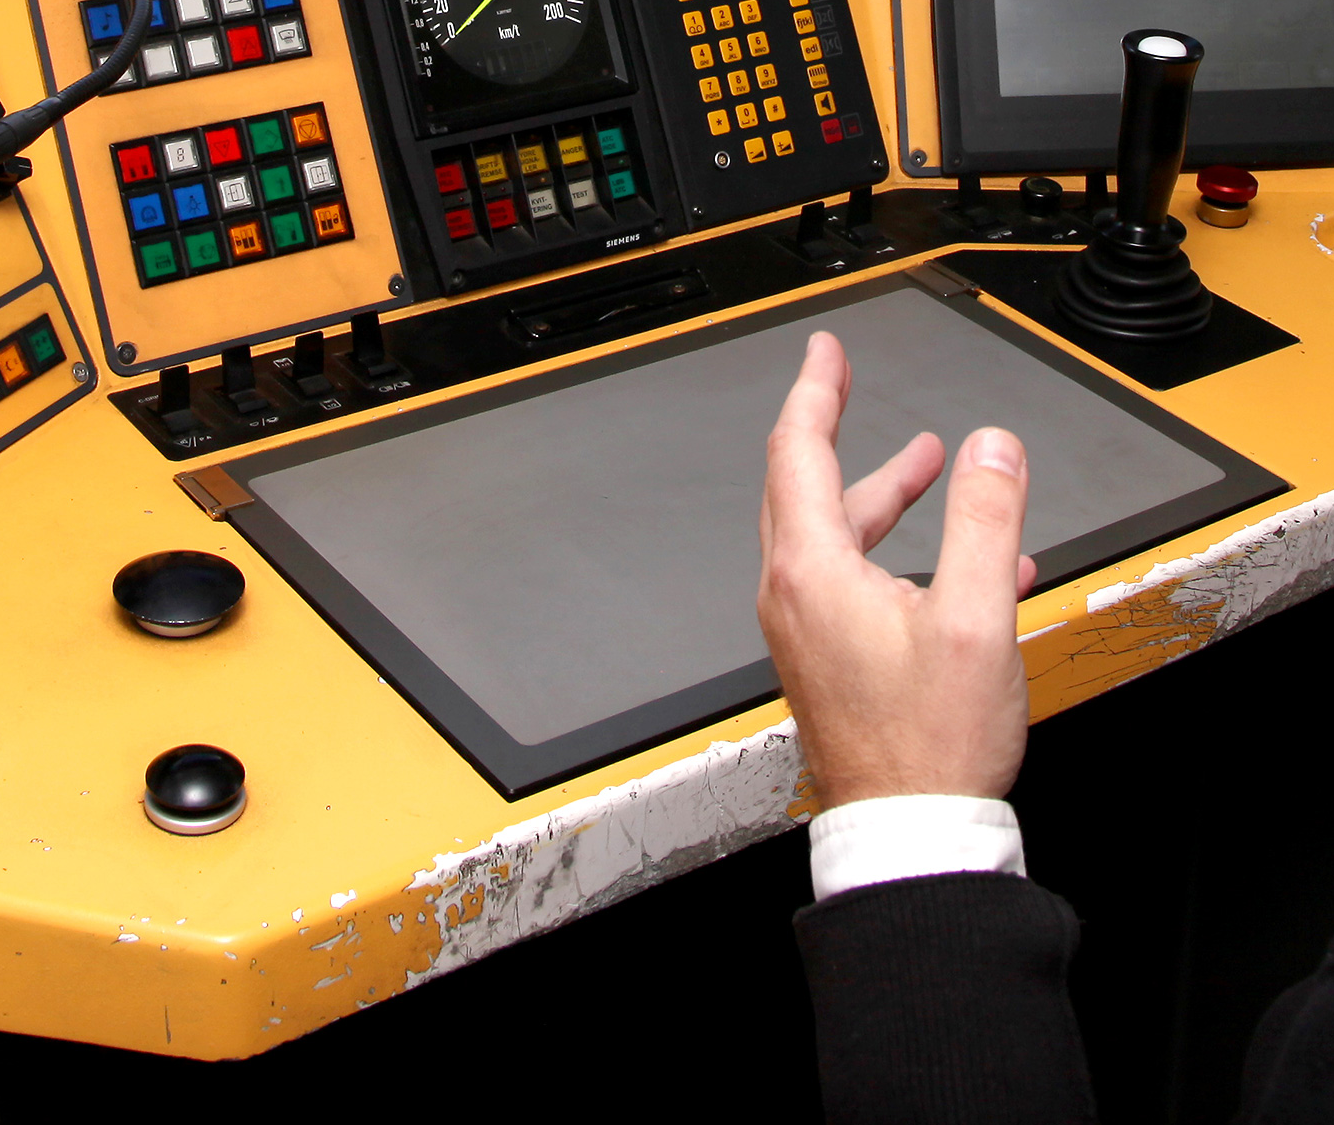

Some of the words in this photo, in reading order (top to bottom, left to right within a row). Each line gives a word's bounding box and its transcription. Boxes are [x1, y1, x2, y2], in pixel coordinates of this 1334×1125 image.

[543, 2, 564, 21] 200
[747, 4, 753, 13] 3
[719, 10, 725, 19] 2
[447, 22, 456, 39] 0
[498, 23, 521, 40] km/t
[755, 37, 761, 45] 6
[728, 43, 734, 52] 5
[699, 49, 705, 57] 4
[763, 69, 769, 77] 9
[735, 75, 741, 84] 8
[743, 108, 750, 117] 0
[572, 190, 589, 199] TEST
[531, 196, 547, 205] KVIT-
[606, 233, 641, 248] SIEMENS
